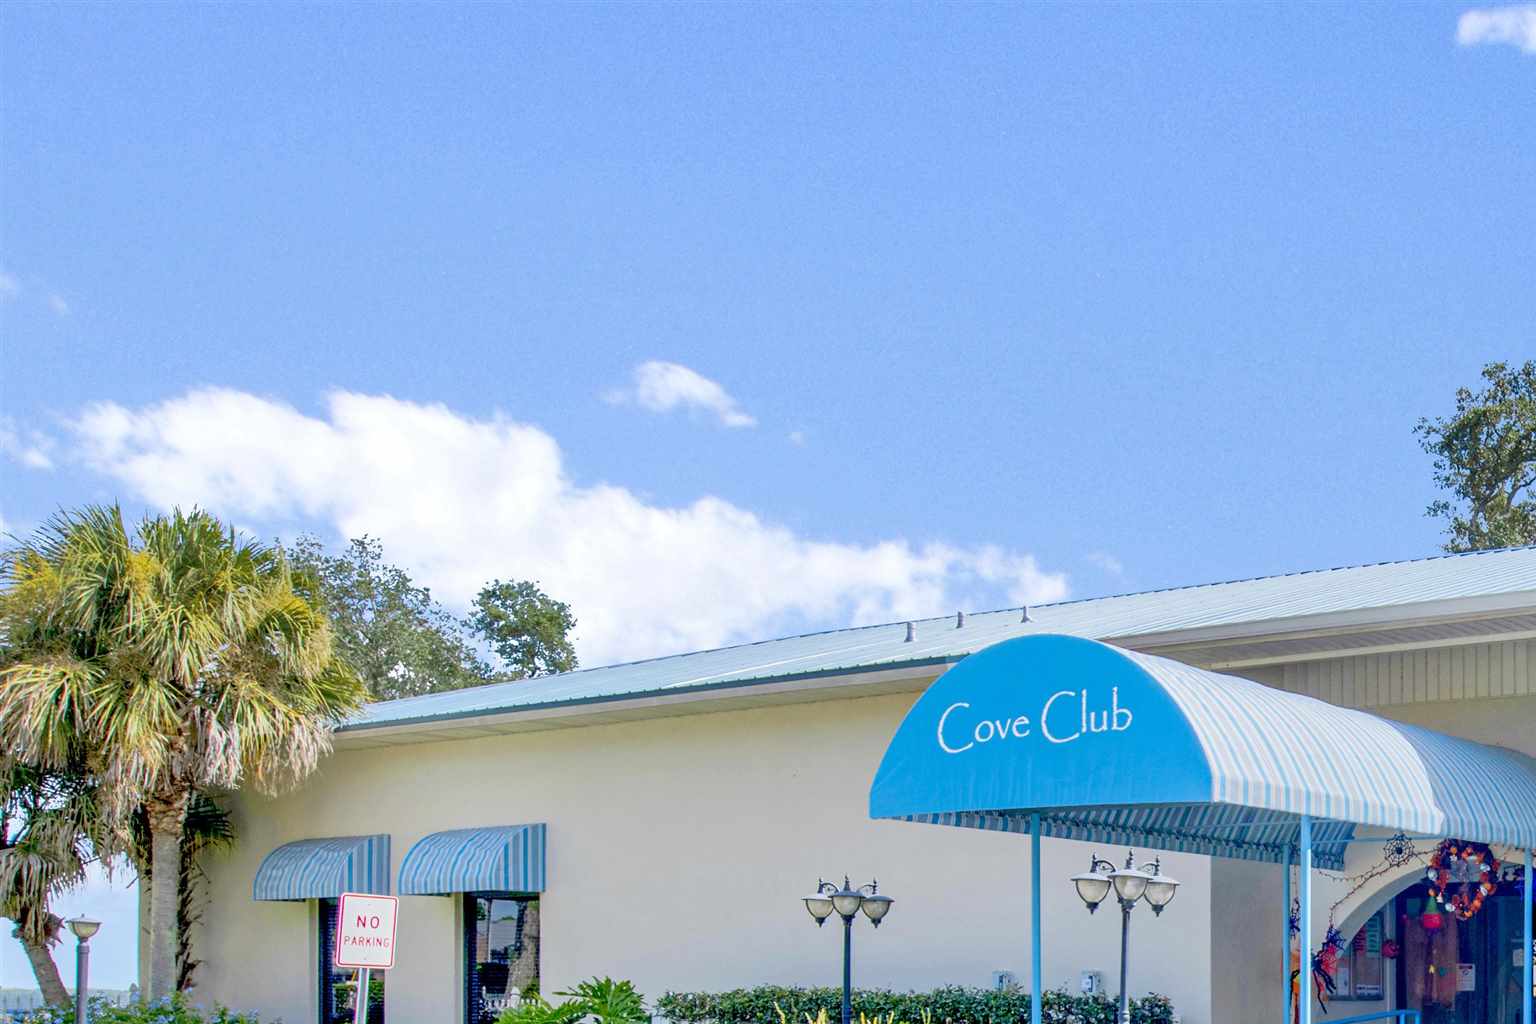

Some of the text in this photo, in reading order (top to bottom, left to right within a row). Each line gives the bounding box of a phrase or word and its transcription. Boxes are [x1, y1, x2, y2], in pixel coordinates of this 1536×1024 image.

[937, 686, 1133, 754] Cove Club
[356, 915, 380, 929] NO
[344, 936, 390, 948] PARKING
